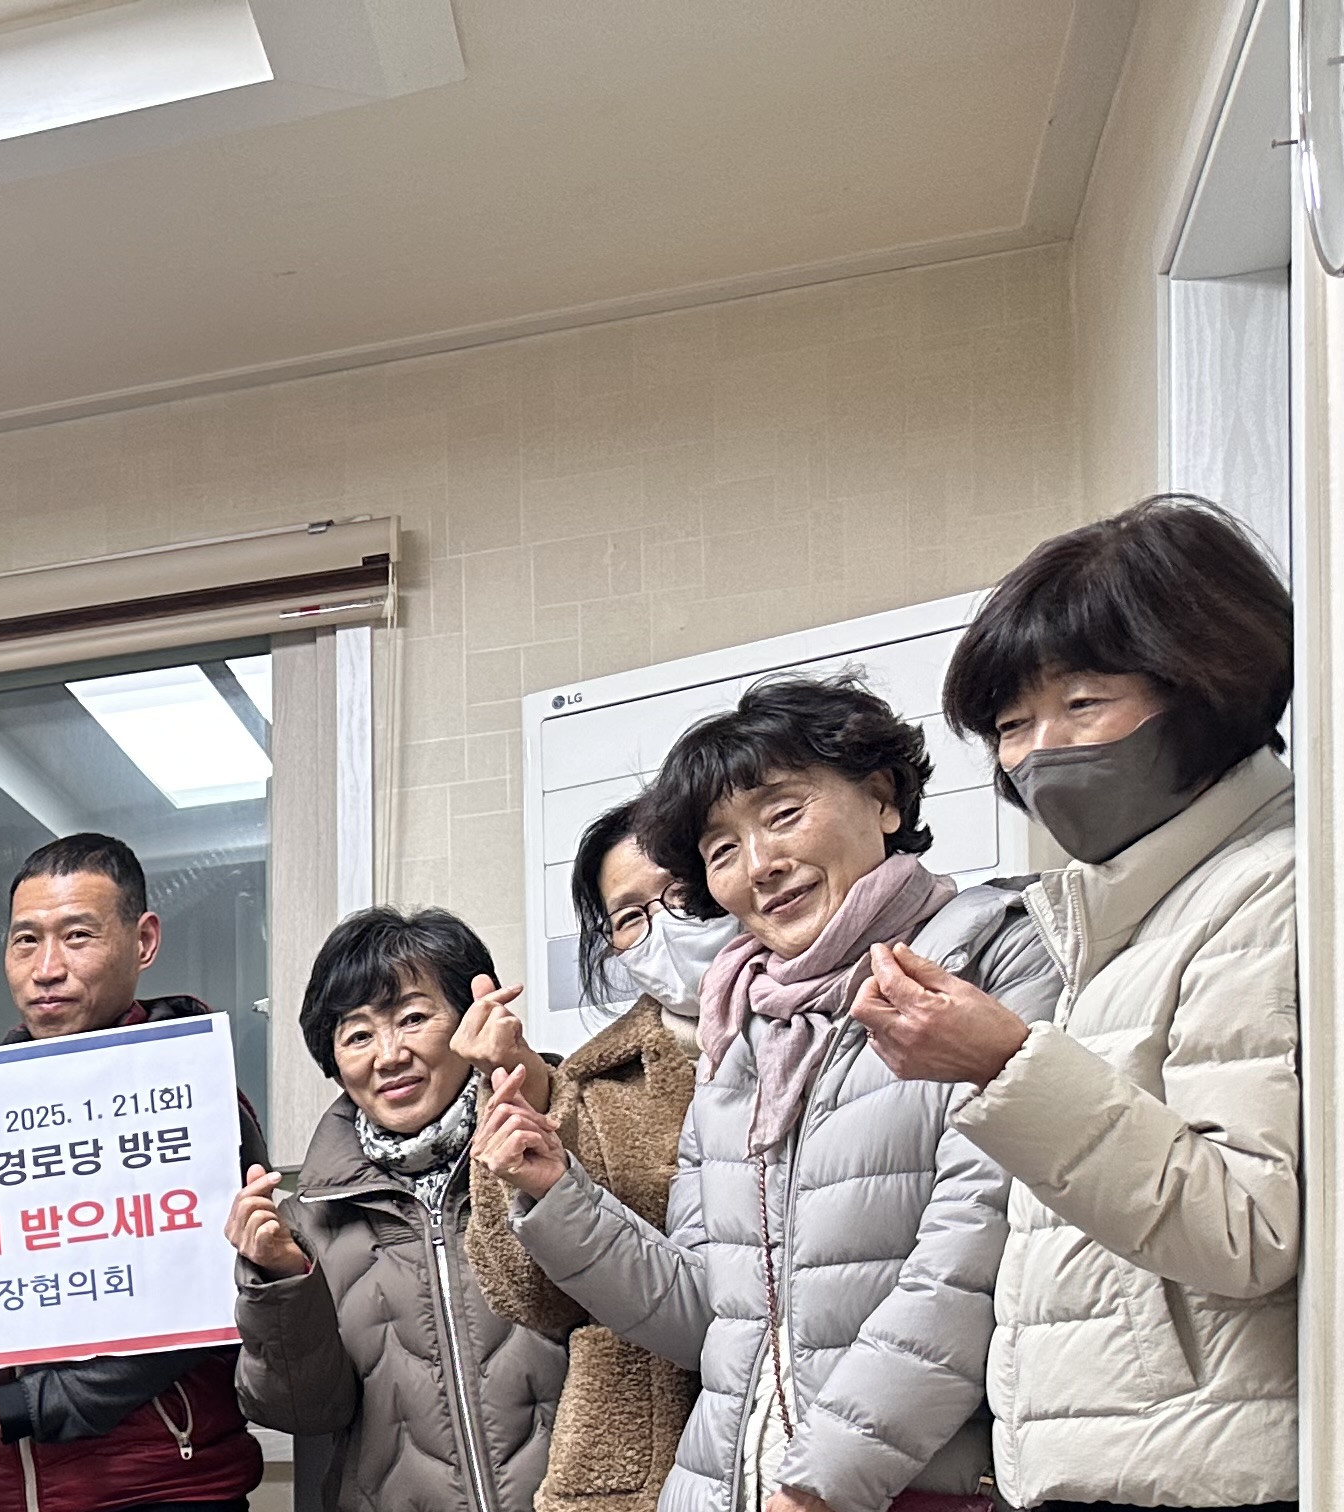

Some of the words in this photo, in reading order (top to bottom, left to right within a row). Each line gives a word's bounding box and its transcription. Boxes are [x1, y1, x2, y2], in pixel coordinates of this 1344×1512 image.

[567, 692, 583, 705] LG
[5, 1103, 72, 1133] 2025.
[83, 1100, 103, 1122] 1.
[118, 1125, 192, 1170] 방문
[20, 1188, 203, 1252] 받으세요
